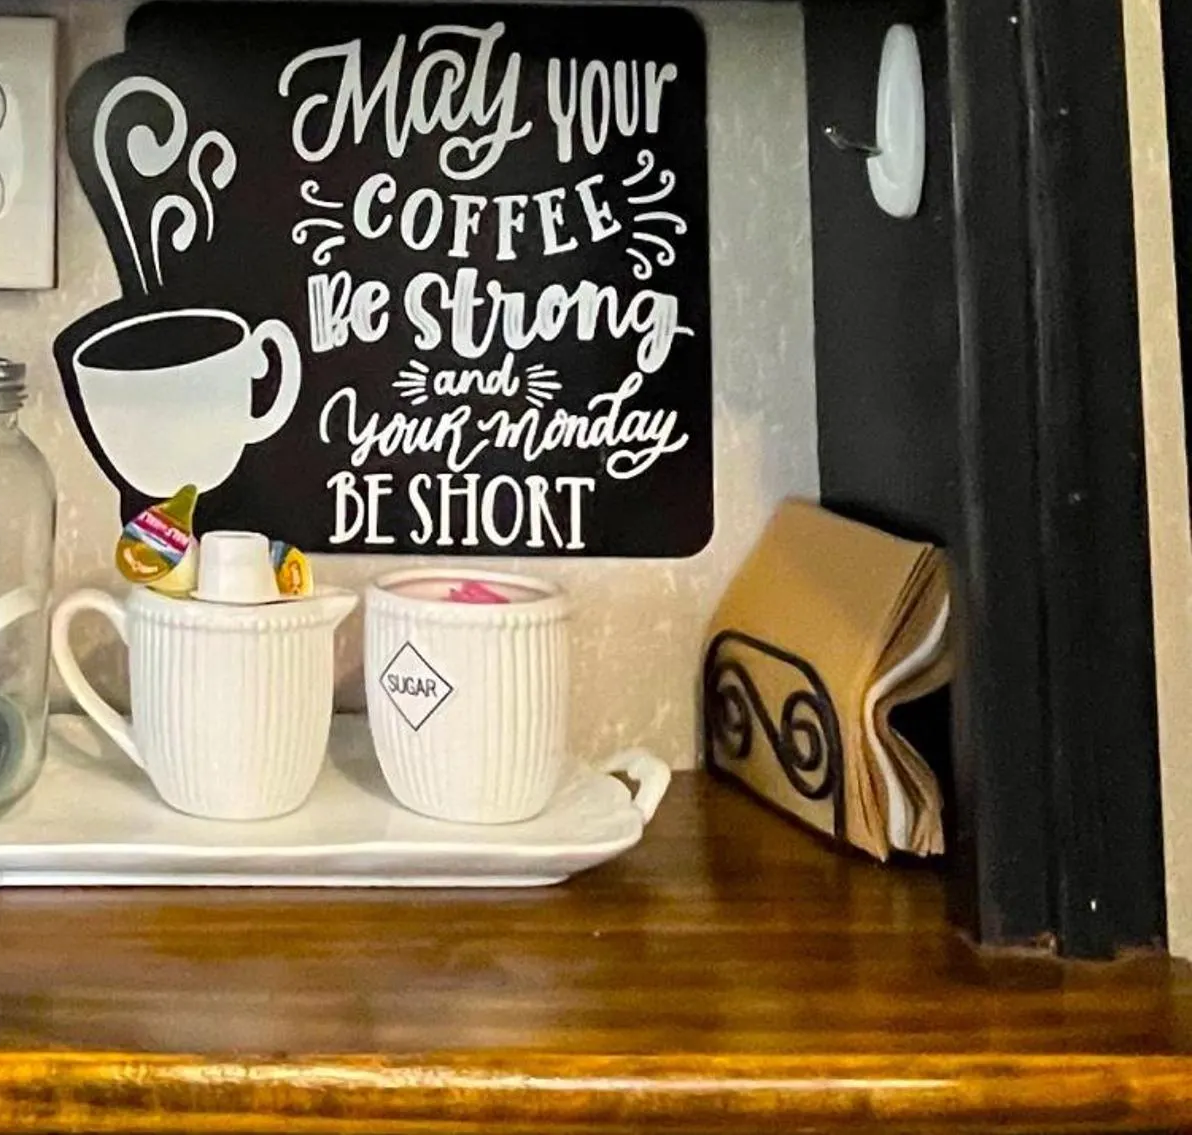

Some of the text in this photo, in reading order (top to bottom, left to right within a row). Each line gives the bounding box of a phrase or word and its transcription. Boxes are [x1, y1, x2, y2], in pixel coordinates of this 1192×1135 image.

[279, 21, 533, 180] May
[353, 172, 622, 261] COFFEE
[307, 270, 390, 353] Be
[433, 352, 520, 396] and
[326, 470, 596, 549] BE SHORT
[387, 673, 438, 698] SUGAR
